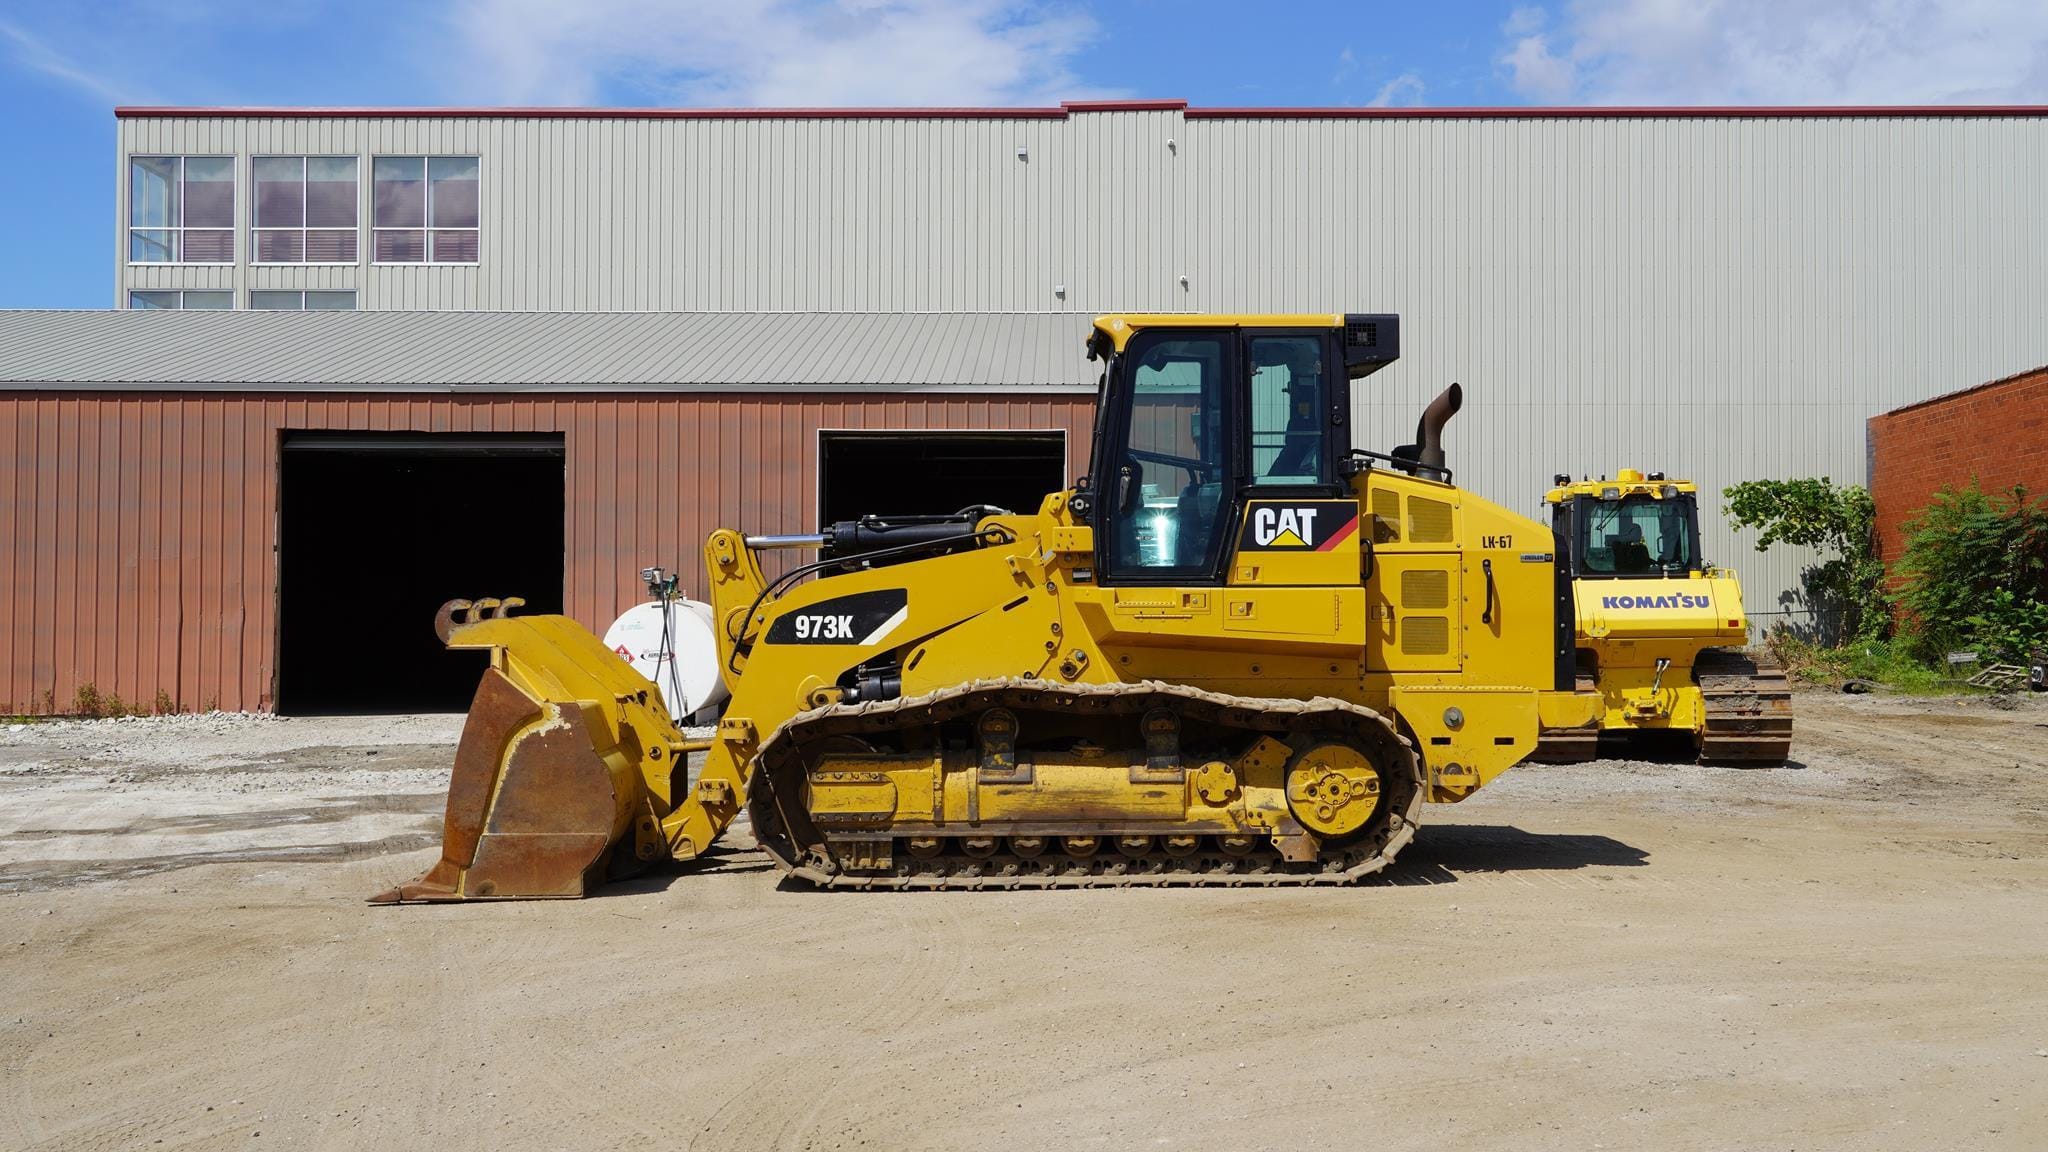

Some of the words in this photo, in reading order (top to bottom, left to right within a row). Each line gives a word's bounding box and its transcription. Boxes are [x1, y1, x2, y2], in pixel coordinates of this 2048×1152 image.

[1254, 507, 1318, 546] CAT
[1482, 535, 1512, 549] LK-67
[1602, 592, 1710, 609] KOMATSU
[795, 614, 854, 639] 973K
